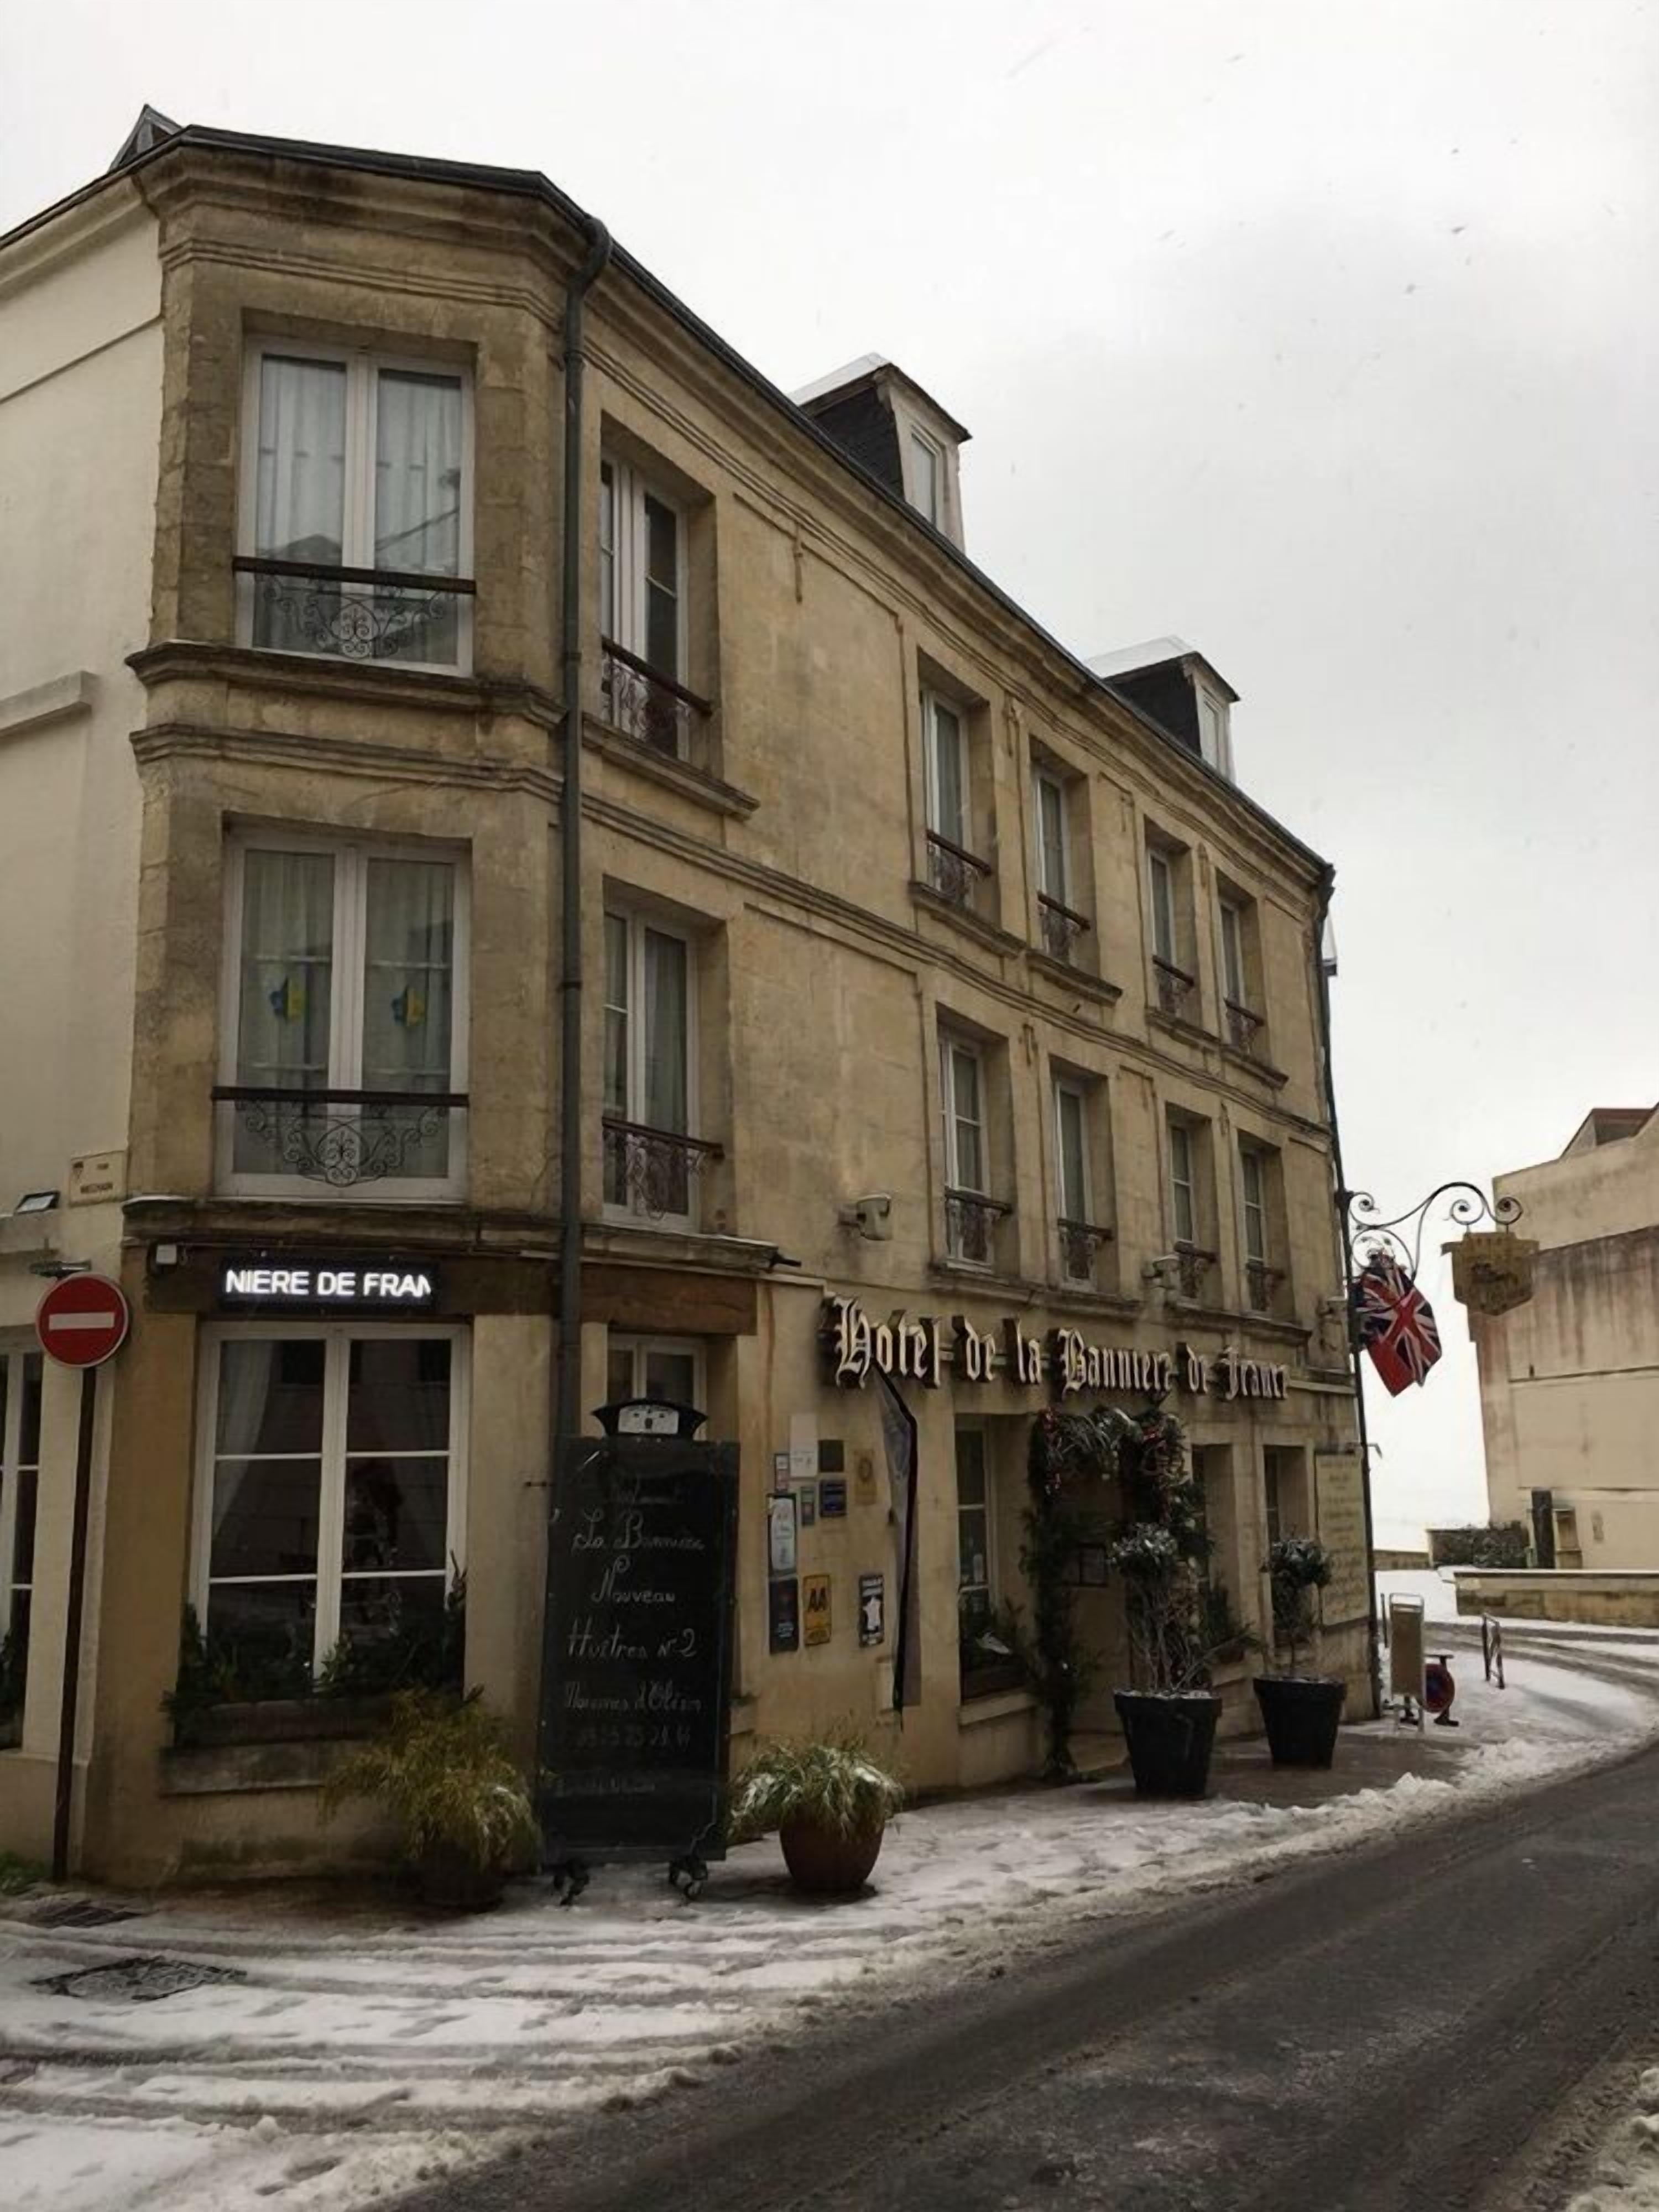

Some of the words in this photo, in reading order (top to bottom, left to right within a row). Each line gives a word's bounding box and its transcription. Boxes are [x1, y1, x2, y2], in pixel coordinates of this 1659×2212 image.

[226, 1270, 309, 1294] NIERE
[317, 1272, 356, 1296] DE
[1012, 1318, 1042, 1383] la
[591, 1554, 676, 1603] Nouveau
